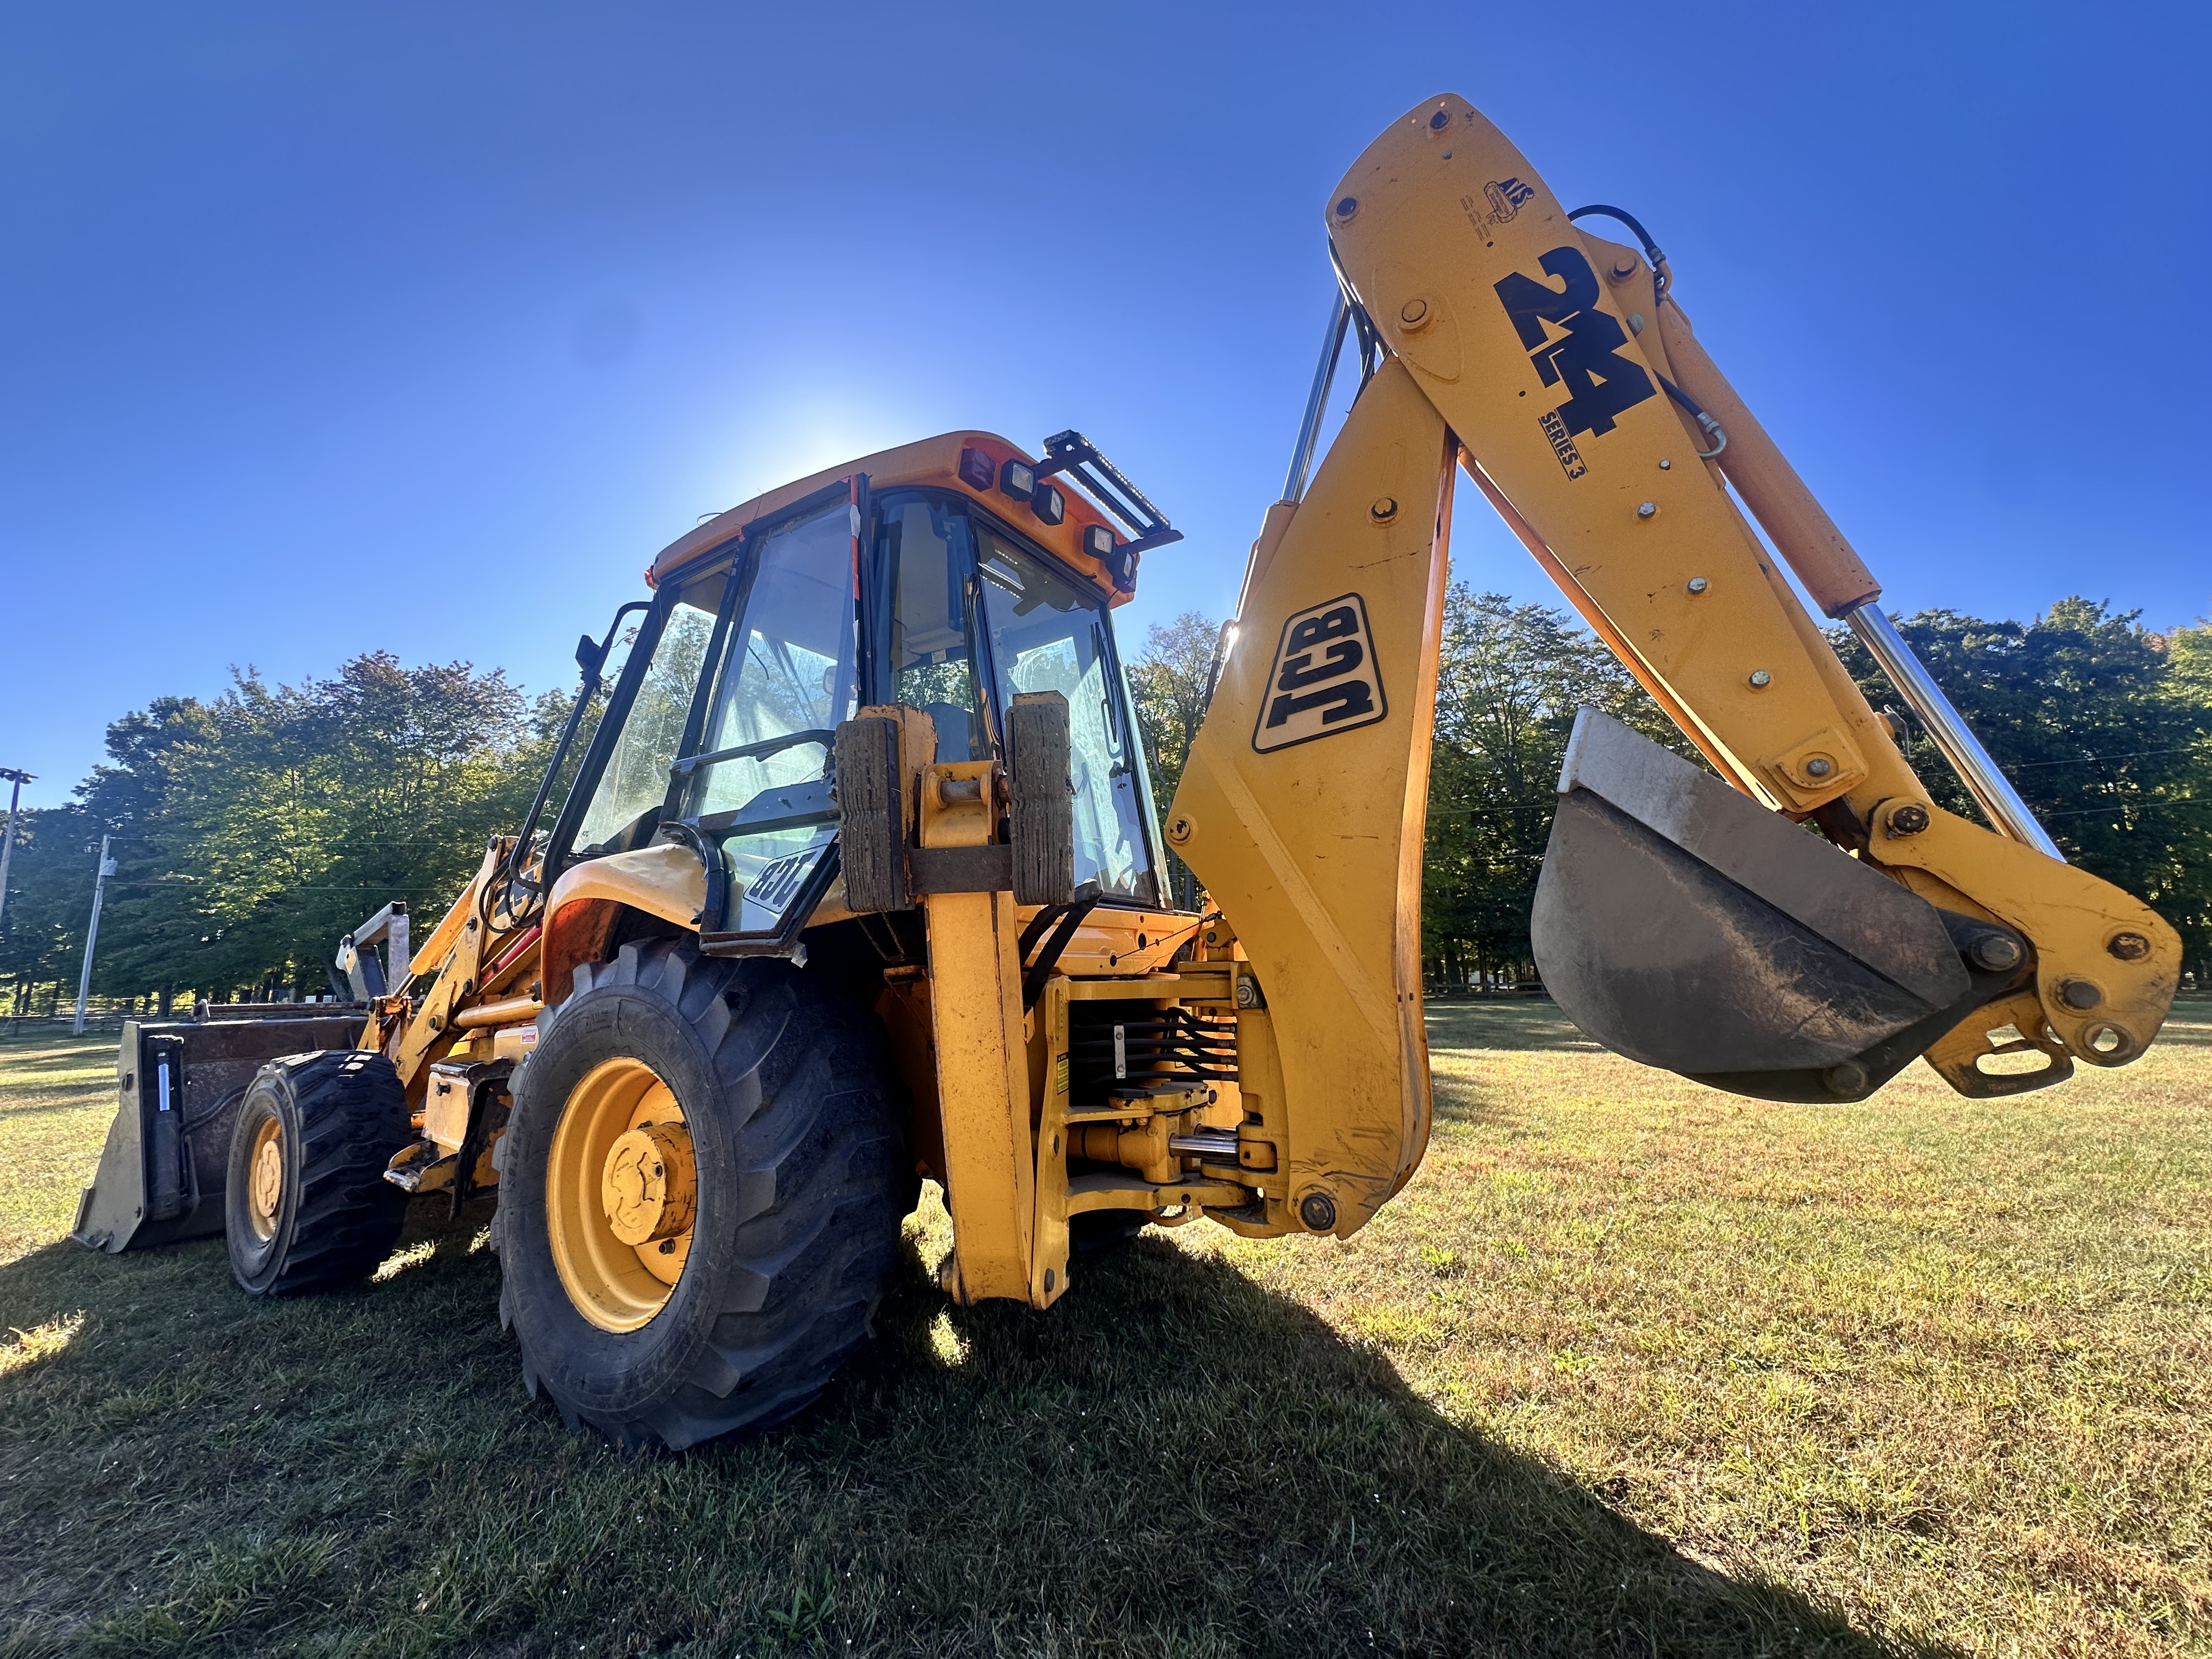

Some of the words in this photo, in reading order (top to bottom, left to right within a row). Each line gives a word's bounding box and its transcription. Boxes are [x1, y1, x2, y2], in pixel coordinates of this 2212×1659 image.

[1499, 177, 1534, 208] AIS
[1493, 246, 1657, 438] 214
[1541, 411, 1578, 466] SERIES
[1569, 467, 1585, 479] 3
[1266, 606, 1373, 729] JCB
